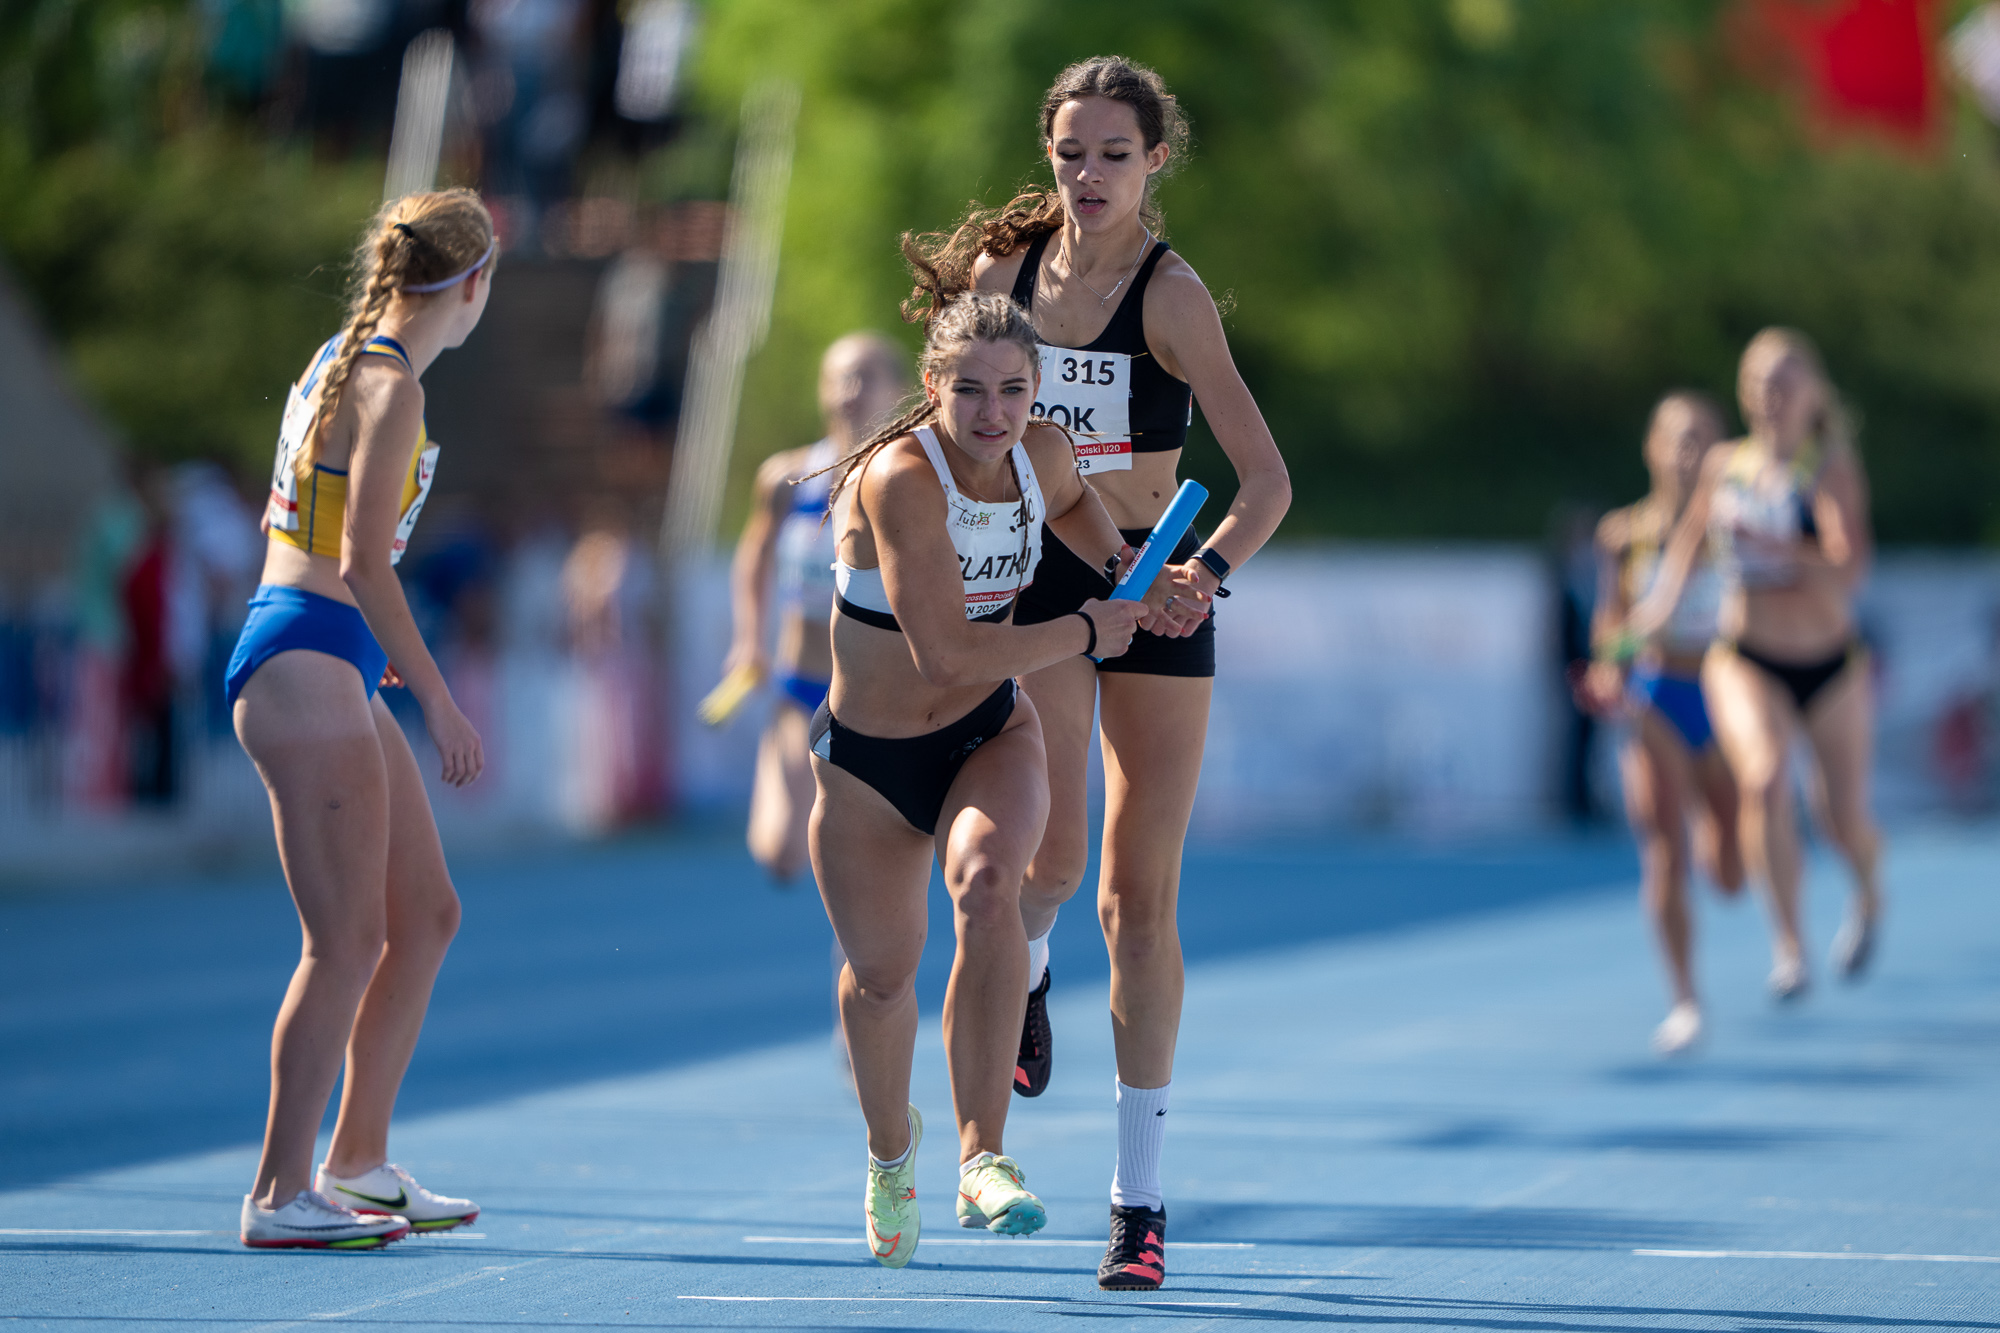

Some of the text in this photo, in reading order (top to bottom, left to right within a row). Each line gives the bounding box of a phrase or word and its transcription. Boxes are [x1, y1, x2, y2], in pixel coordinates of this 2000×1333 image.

[1061, 357, 1115, 386] 315
[1075, 444, 1121, 456] Polski U20
